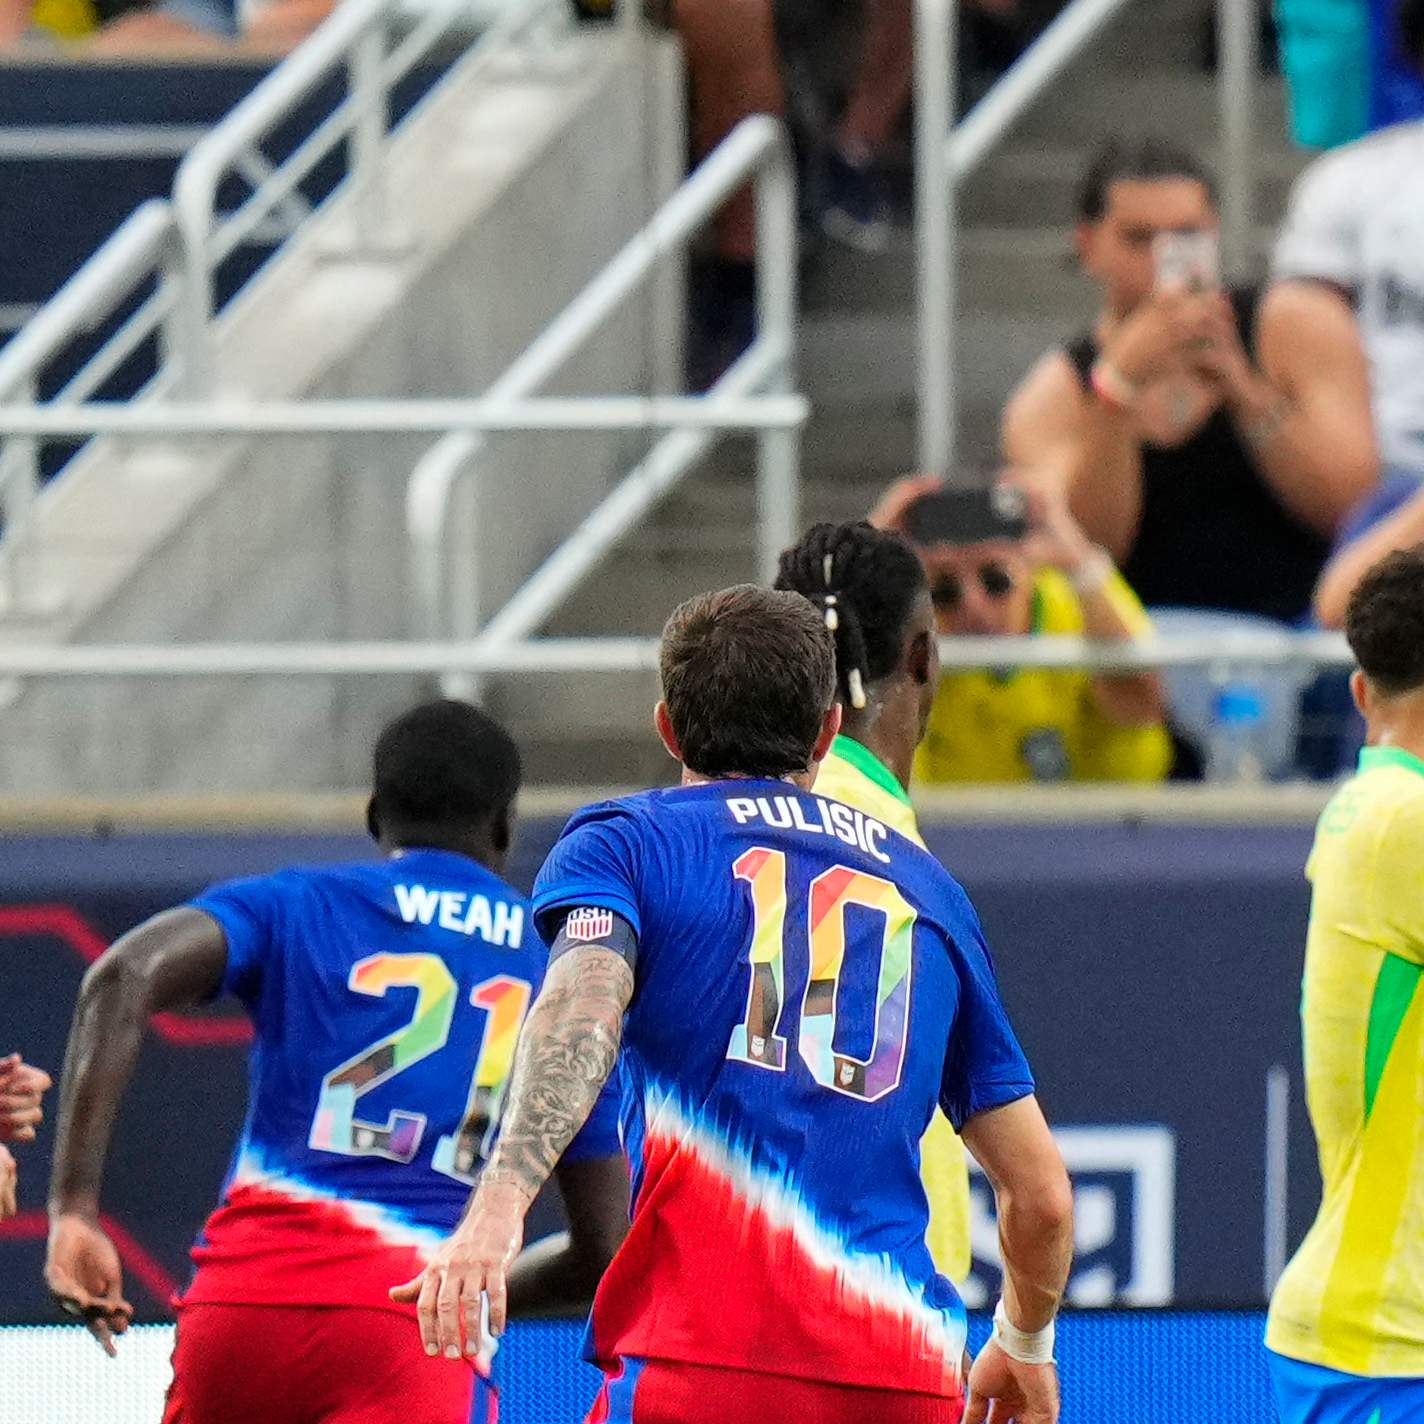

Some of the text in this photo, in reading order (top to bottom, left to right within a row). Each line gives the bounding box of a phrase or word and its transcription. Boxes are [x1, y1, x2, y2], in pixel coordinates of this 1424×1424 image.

[726, 797, 891, 864] PULISIC
[393, 883, 525, 950] WEAH
[726, 846, 918, 1103] 10
[307, 950, 534, 1187] 21
